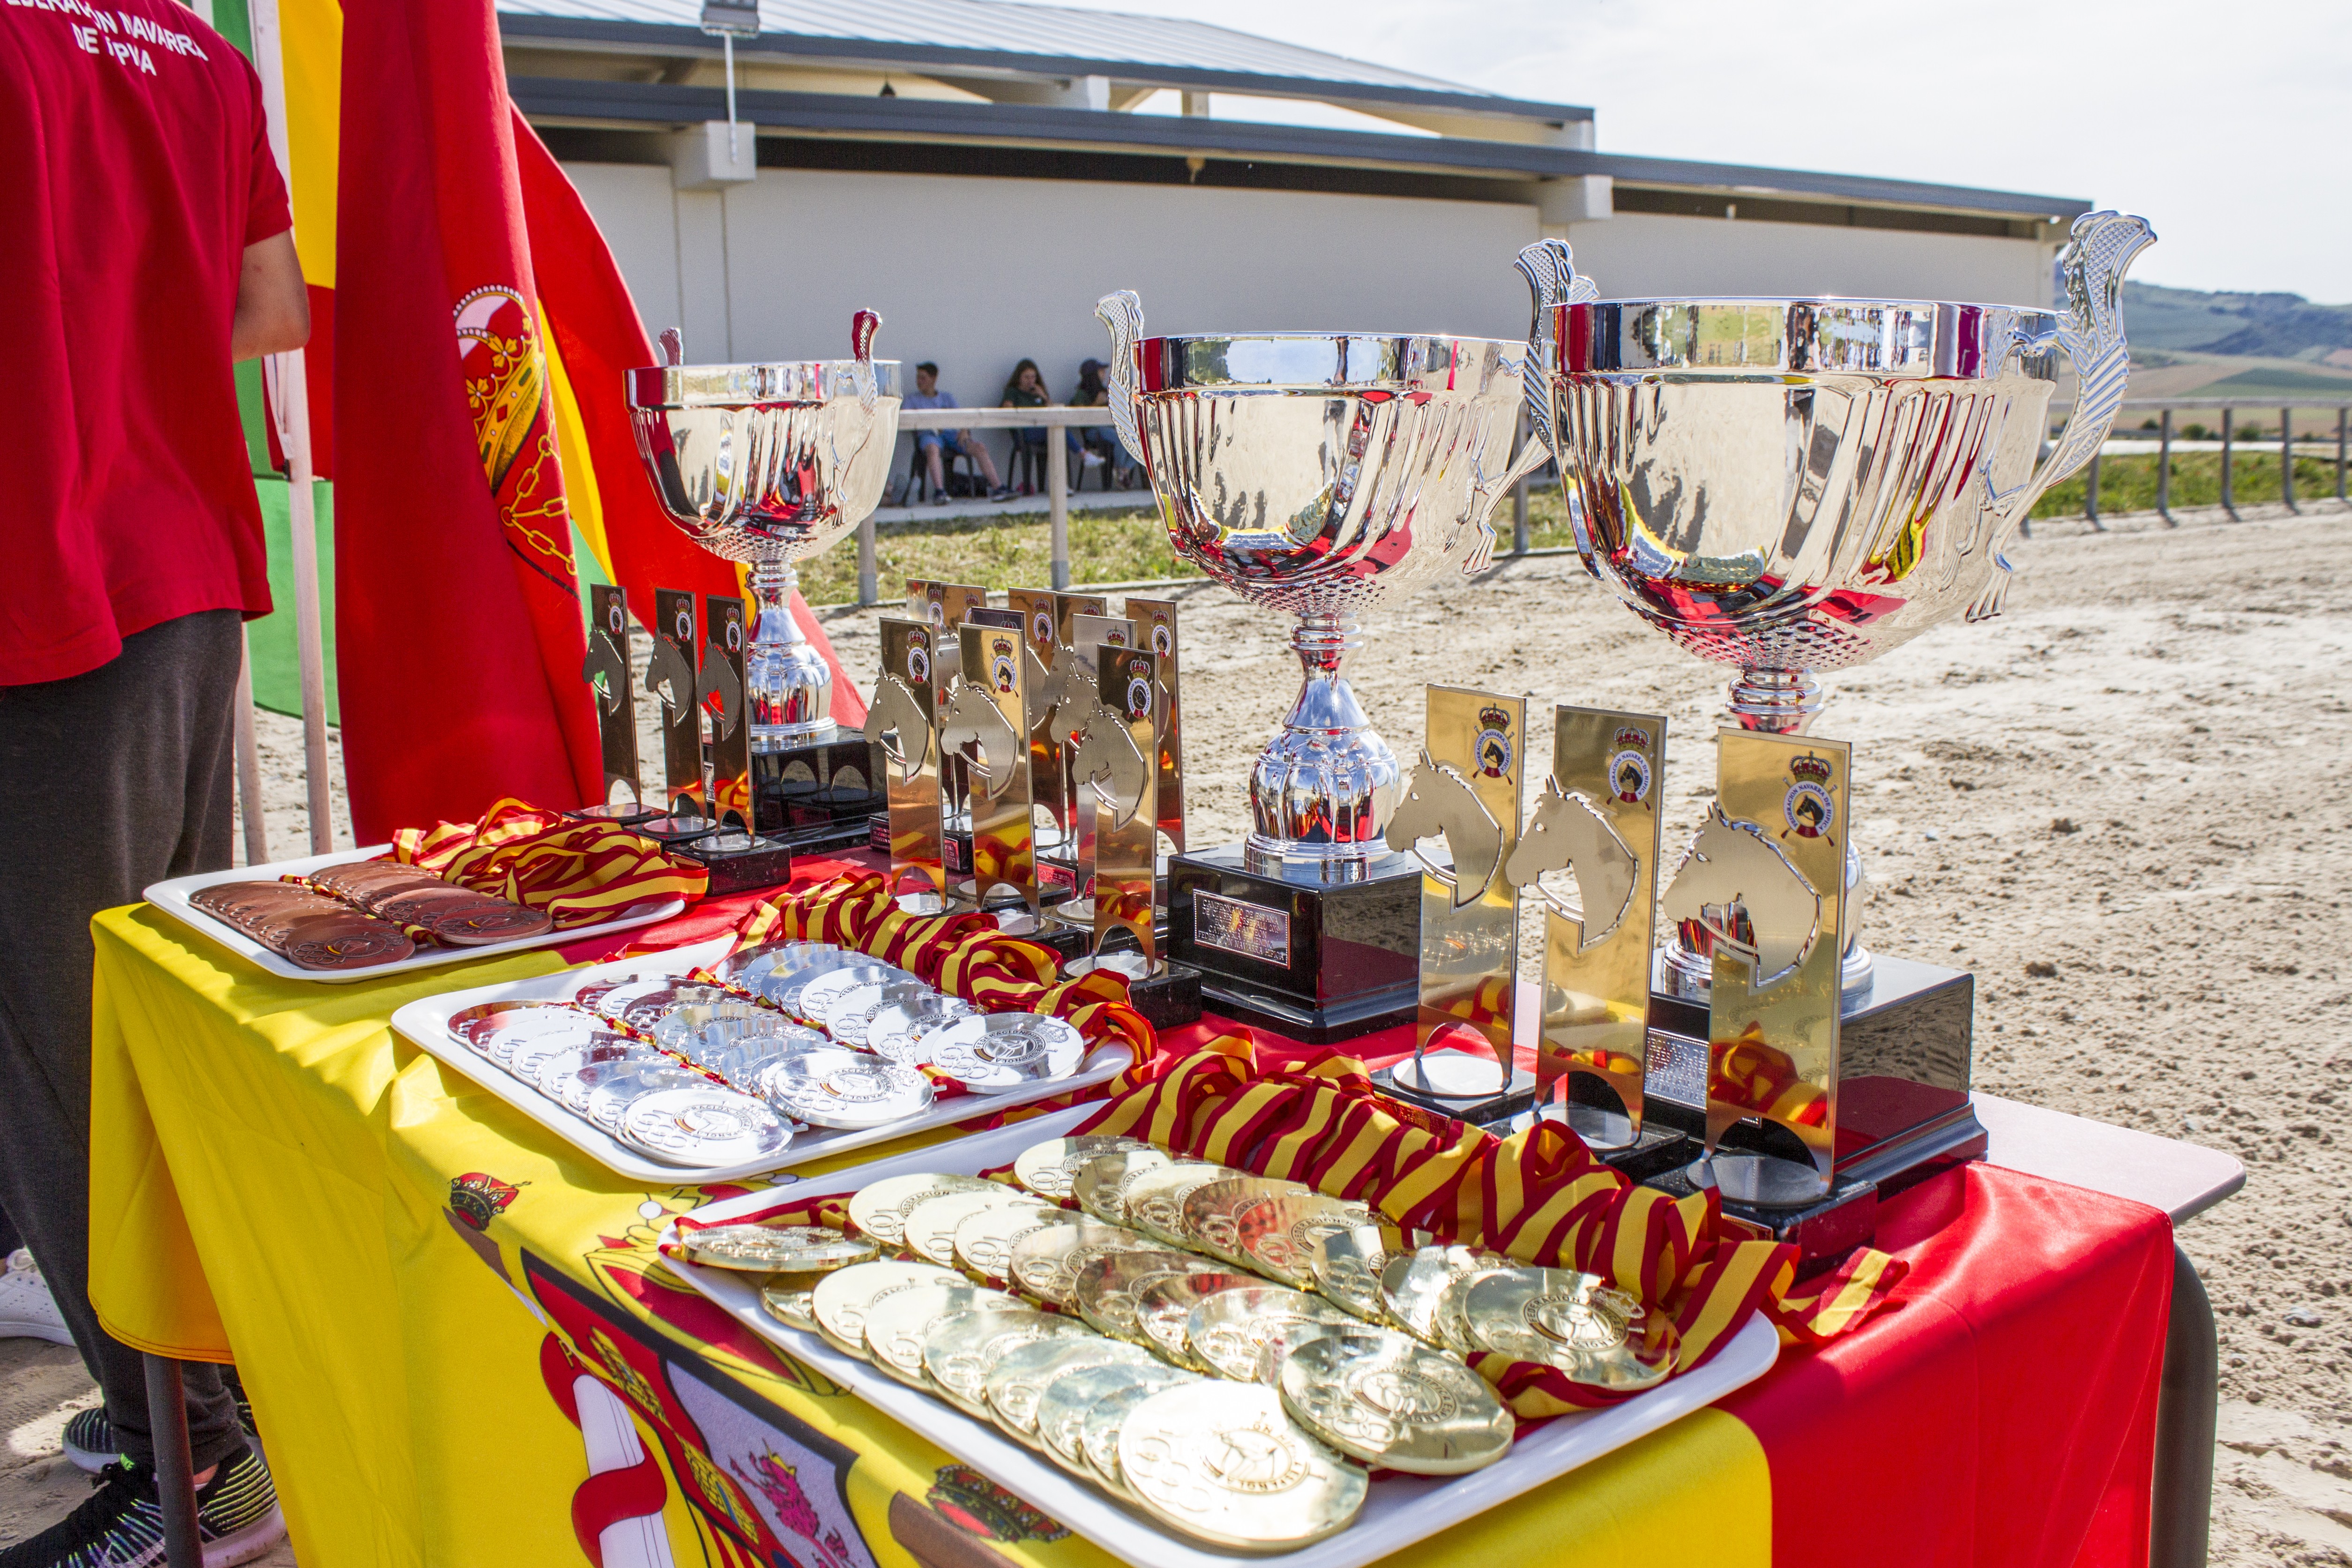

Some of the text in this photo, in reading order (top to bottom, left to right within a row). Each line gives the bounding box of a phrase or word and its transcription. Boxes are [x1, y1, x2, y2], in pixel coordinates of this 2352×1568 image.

[71, 22, 99, 54] DE
[117, 11, 209, 61] NAVARRA
[1477, 735, 1486, 769] FEDERACION
[1485, 732, 1505, 742] NAVARRA
[1500, 753, 1510, 771] HIPICA
[1612, 753, 1649, 796] FEDERACION NAVARRA DE HIPICA
[1787, 784, 1831, 831] FEDERACION NAVARRA DE HIPICA
[1202, 907, 1210, 916] DE
[910, 1014, 947, 1036] FEDERACION
[976, 1030, 1025, 1048] FEDERACION
[1294, 1218, 1340, 1242] FEDERACION
[1527, 1295, 1580, 1322] FEDERACION
